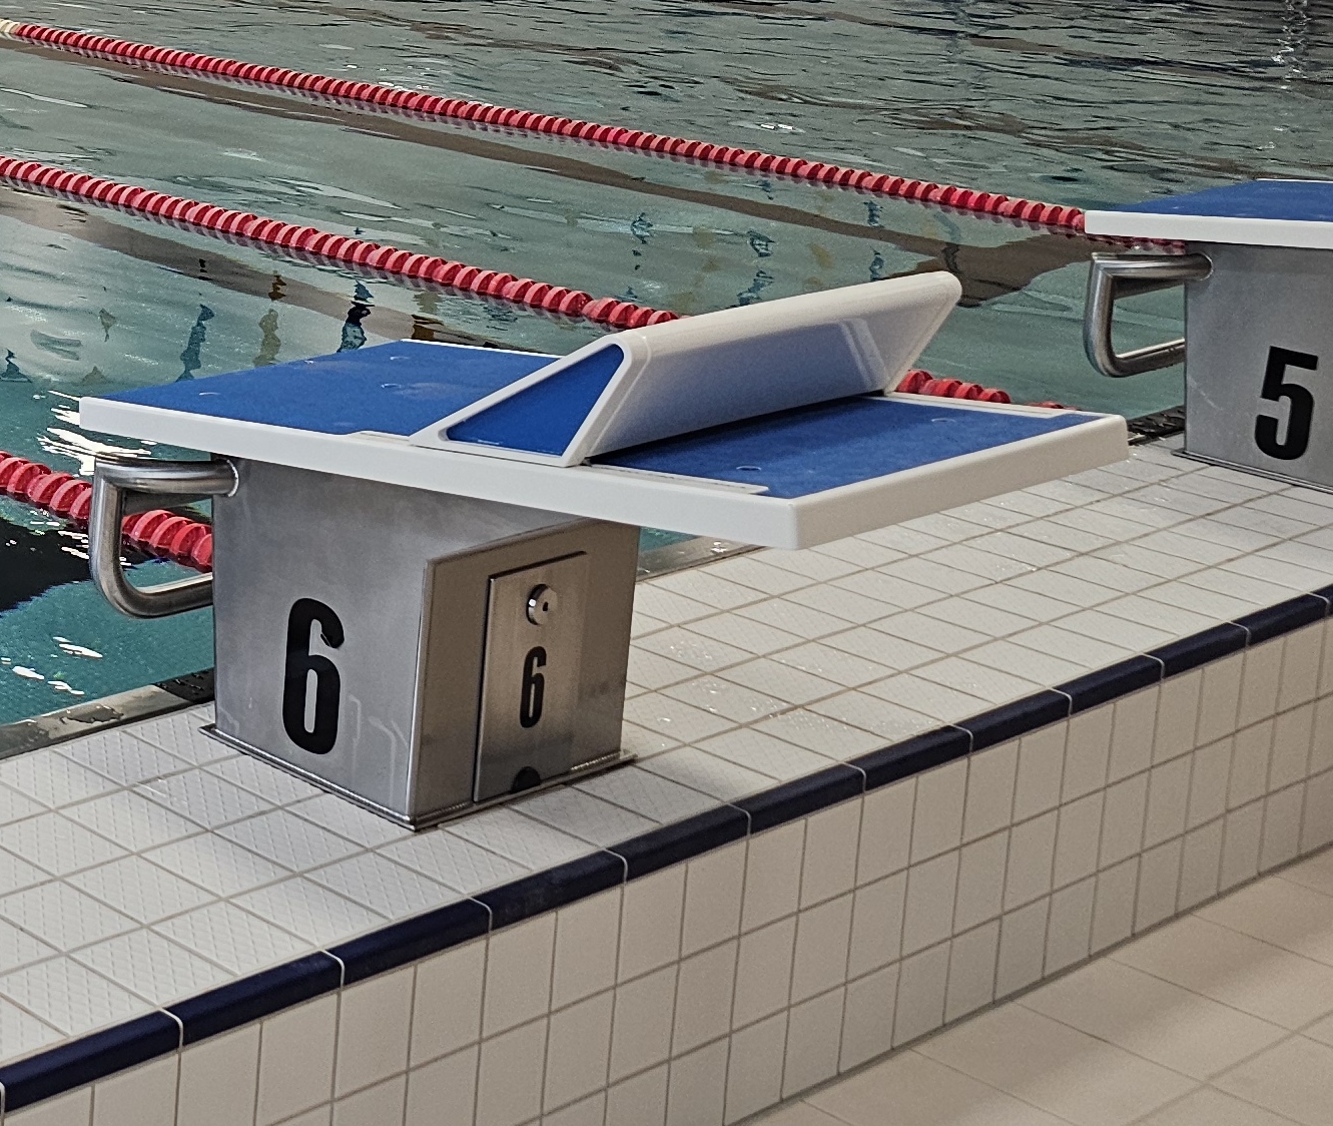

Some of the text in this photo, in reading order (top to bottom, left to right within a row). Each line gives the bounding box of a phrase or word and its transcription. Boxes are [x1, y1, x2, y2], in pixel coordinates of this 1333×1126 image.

[1254, 345, 1319, 461] 5
[282, 597, 344, 755] 6
[519, 646, 547, 729] 6
